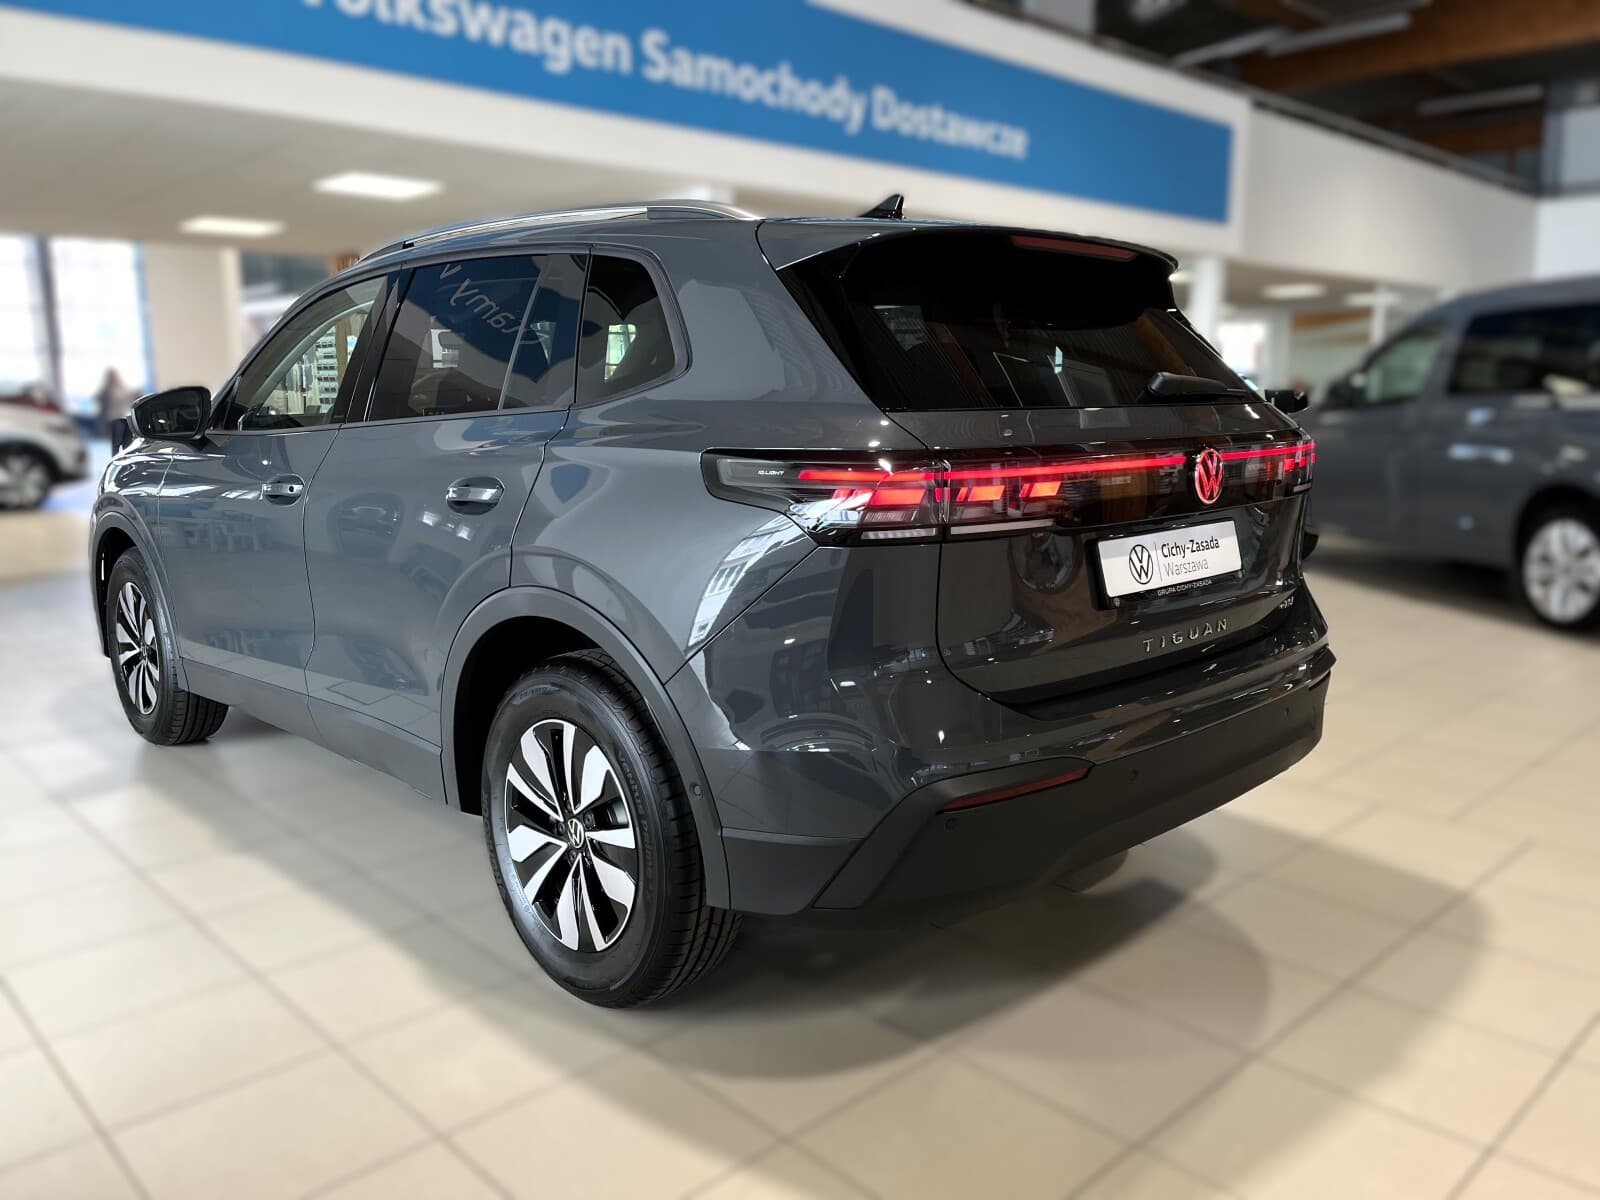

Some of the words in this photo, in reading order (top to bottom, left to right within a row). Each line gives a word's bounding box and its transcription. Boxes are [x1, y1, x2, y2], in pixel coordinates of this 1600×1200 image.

[302, 0, 635, 75] kswagen
[640, 28, 867, 135] Samochody
[871, 84, 1028, 160] Dostawcze
[1161, 536, 1220, 559] Cichy-Zasada
[1129, 544, 1153, 585] VW
[1163, 558, 1209, 577] Warszawa
[1157, 585, 1176, 596] GRUPA
[1176, 579, 1213, 592] CICHY-ZASADA
[1143, 618, 1228, 653] TIGUAN
